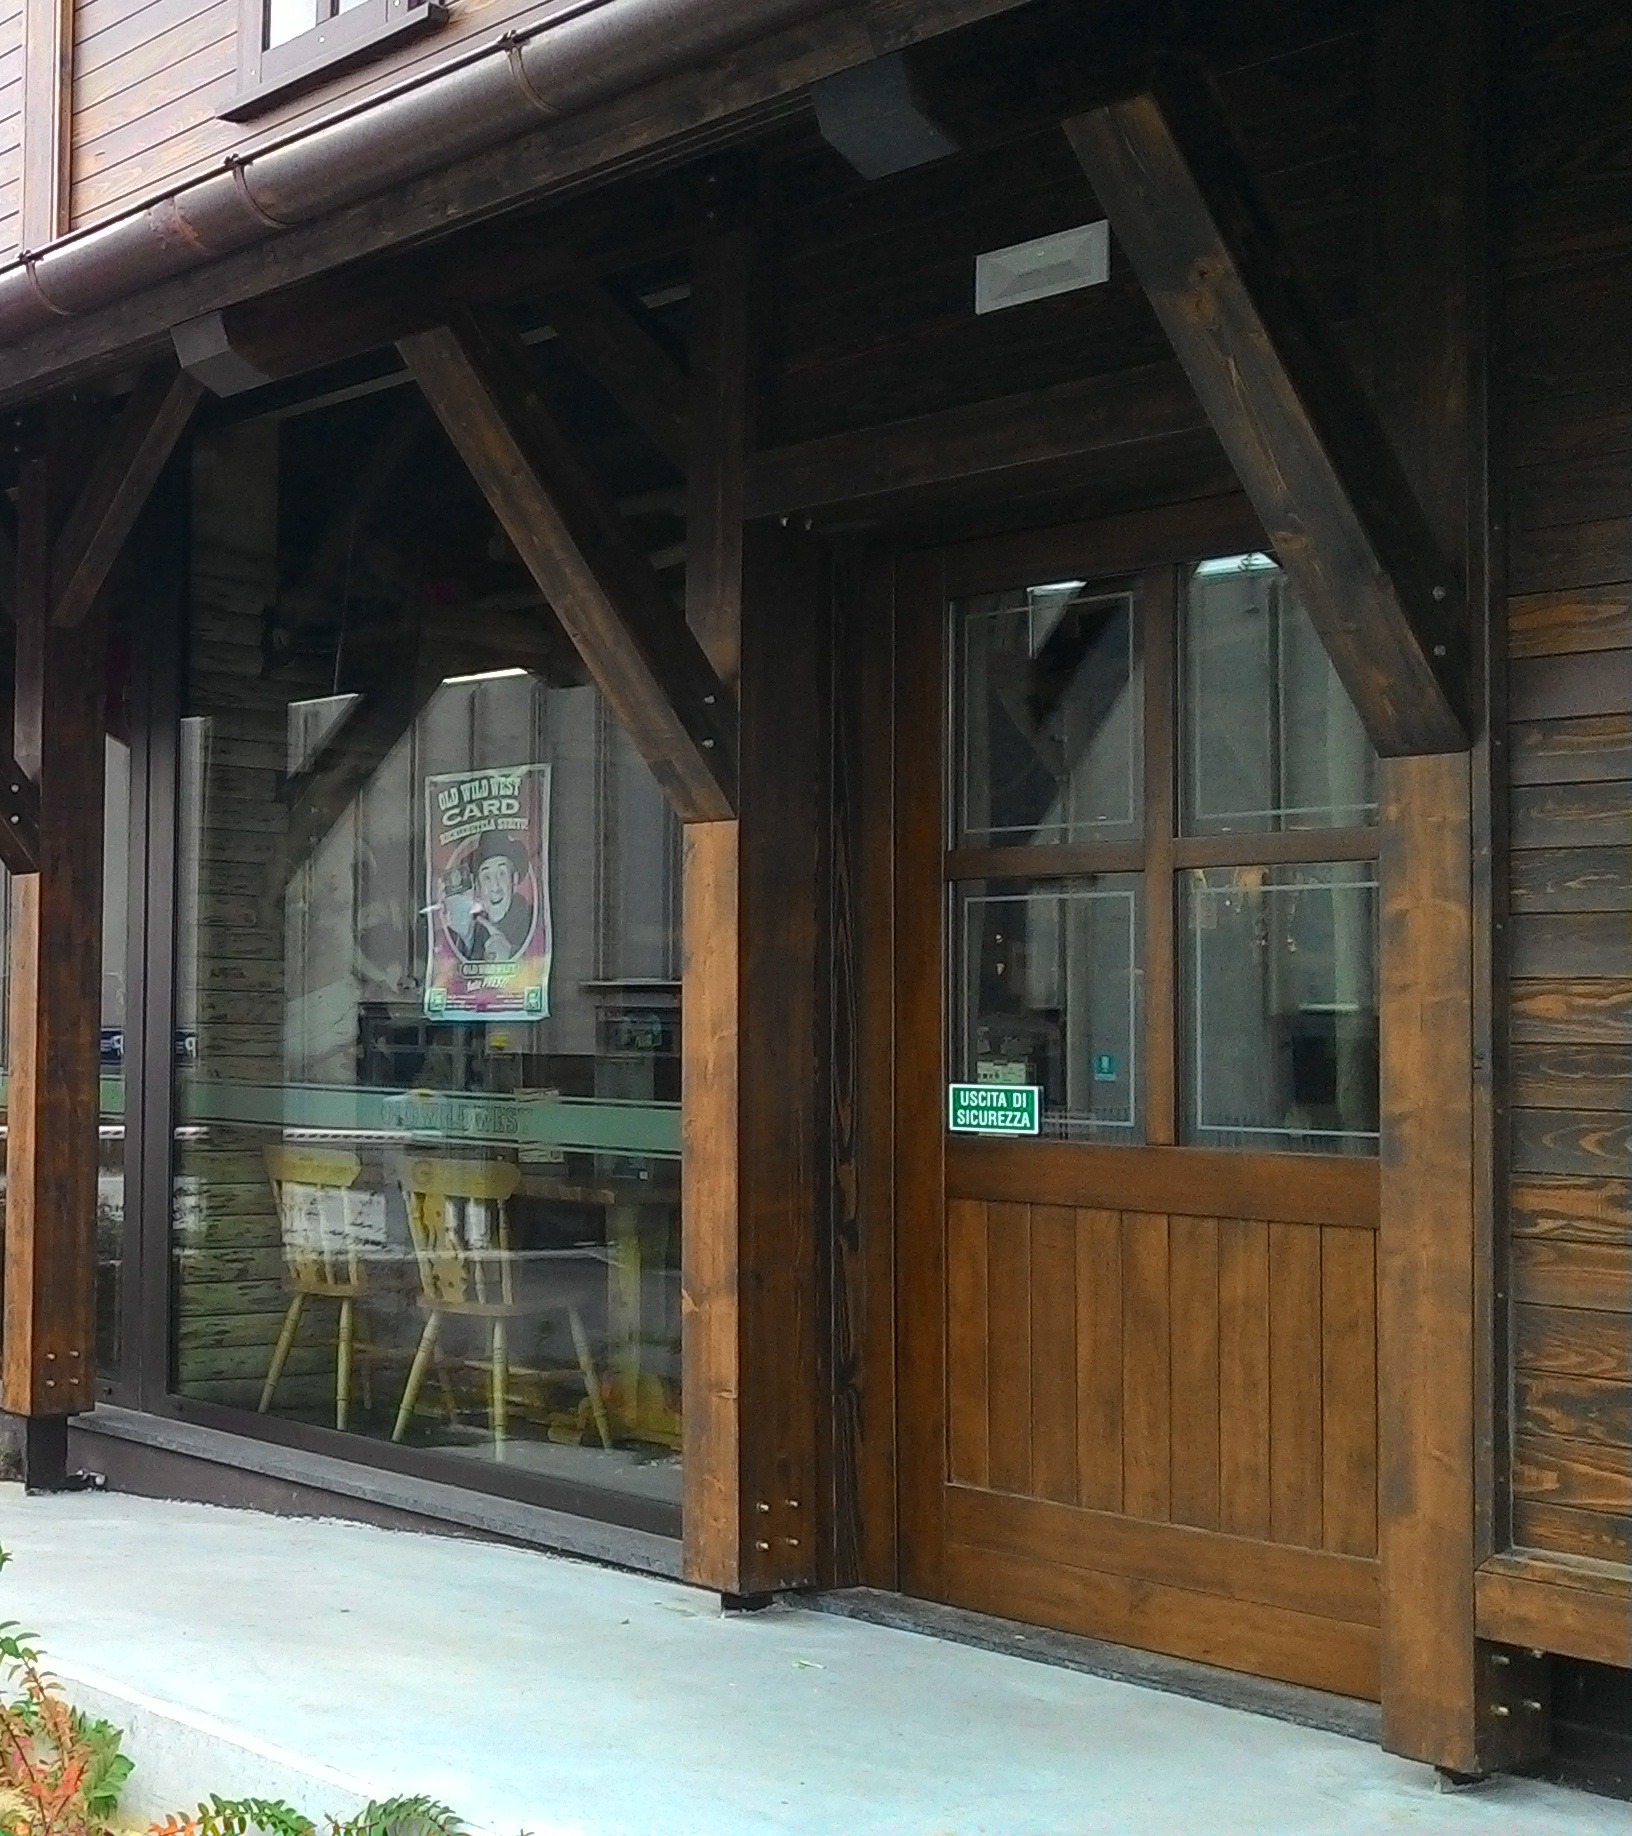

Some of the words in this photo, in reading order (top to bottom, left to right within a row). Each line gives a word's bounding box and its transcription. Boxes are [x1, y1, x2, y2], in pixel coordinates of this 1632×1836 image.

[438, 787, 459, 811] OLD
[460, 779, 488, 803] WILD
[490, 776, 521, 797] WEST
[442, 798, 520, 826] CARD
[960, 1090, 1008, 1108] USCITA
[1012, 1092, 1027, 1108] DI
[956, 1109, 1031, 1128] SICUREZZA
